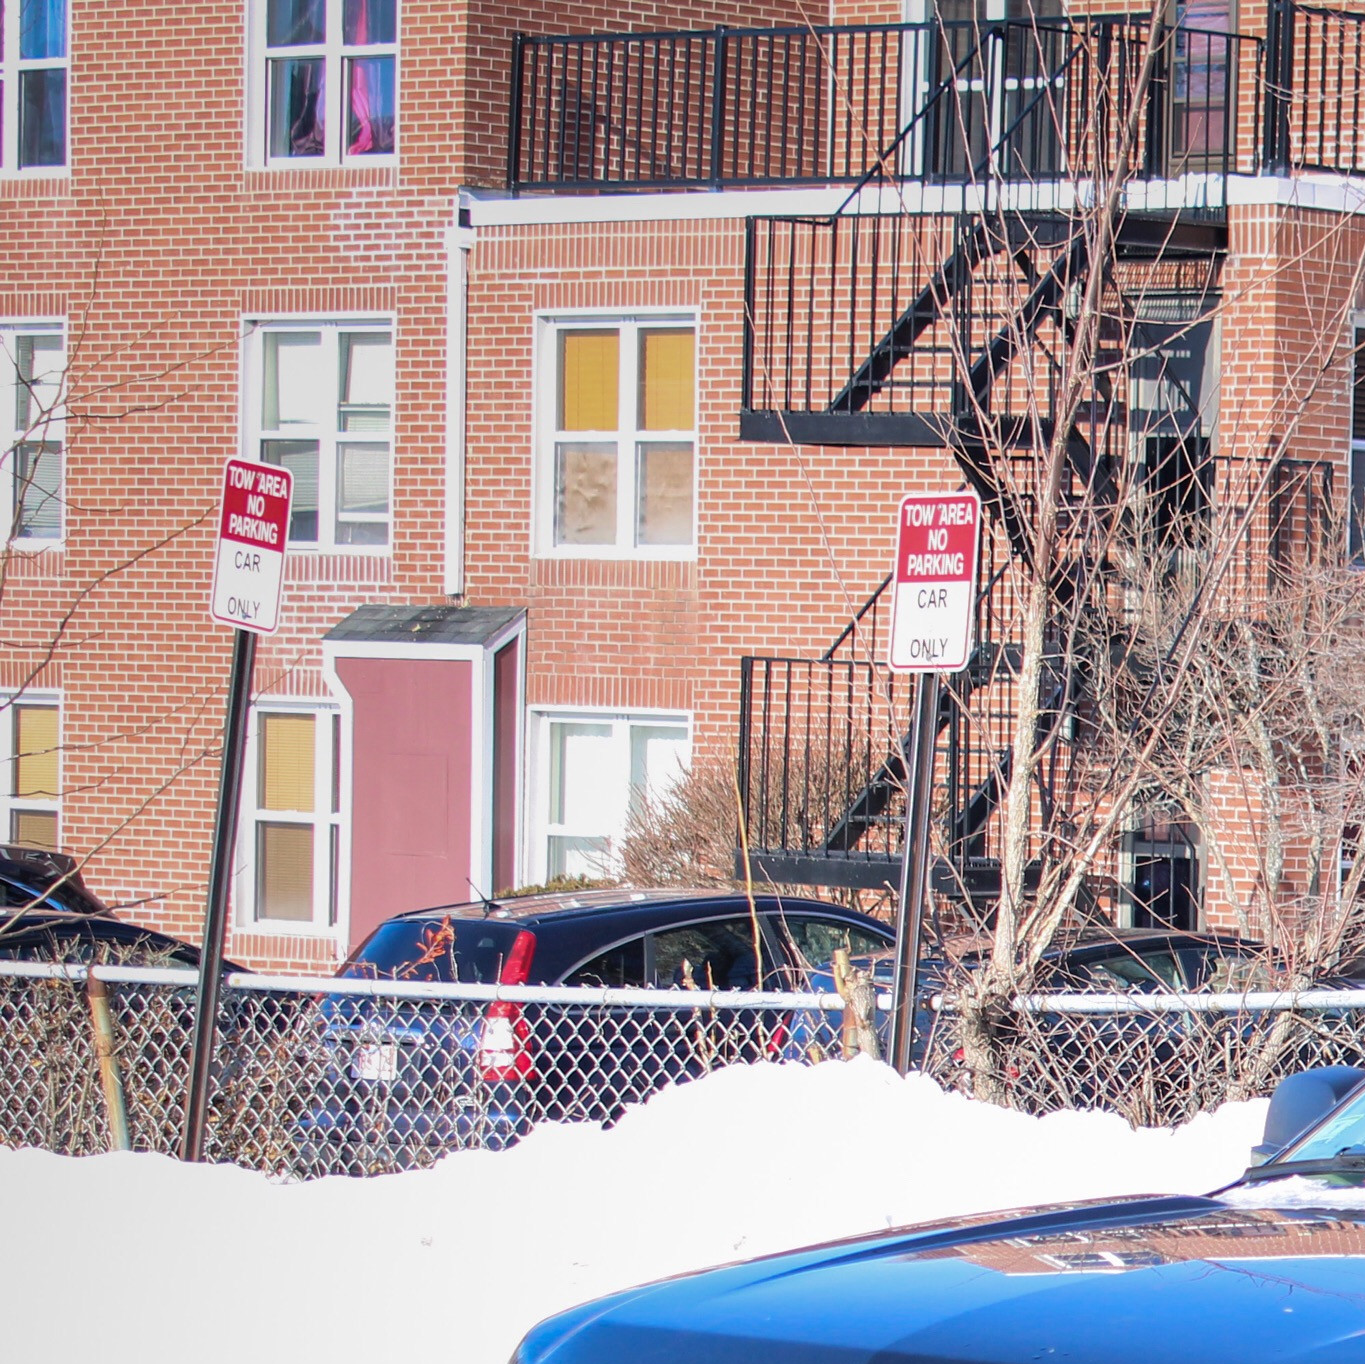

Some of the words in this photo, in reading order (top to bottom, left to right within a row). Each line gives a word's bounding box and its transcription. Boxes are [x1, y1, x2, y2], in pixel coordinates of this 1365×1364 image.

[229, 466, 256, 491] TOW
[258, 473, 288, 499] AREA
[246, 494, 265, 517] NO
[905, 504, 936, 527] TOW
[939, 503, 974, 526] AREA
[228, 513, 278, 545] PARKING
[927, 528, 948, 551] NO
[235, 551, 261, 573] CAR
[907, 552, 964, 576] PARKING
[227, 596, 260, 620] ONLY
[917, 588, 948, 609] CAR
[910, 638, 948, 659] ONLY
